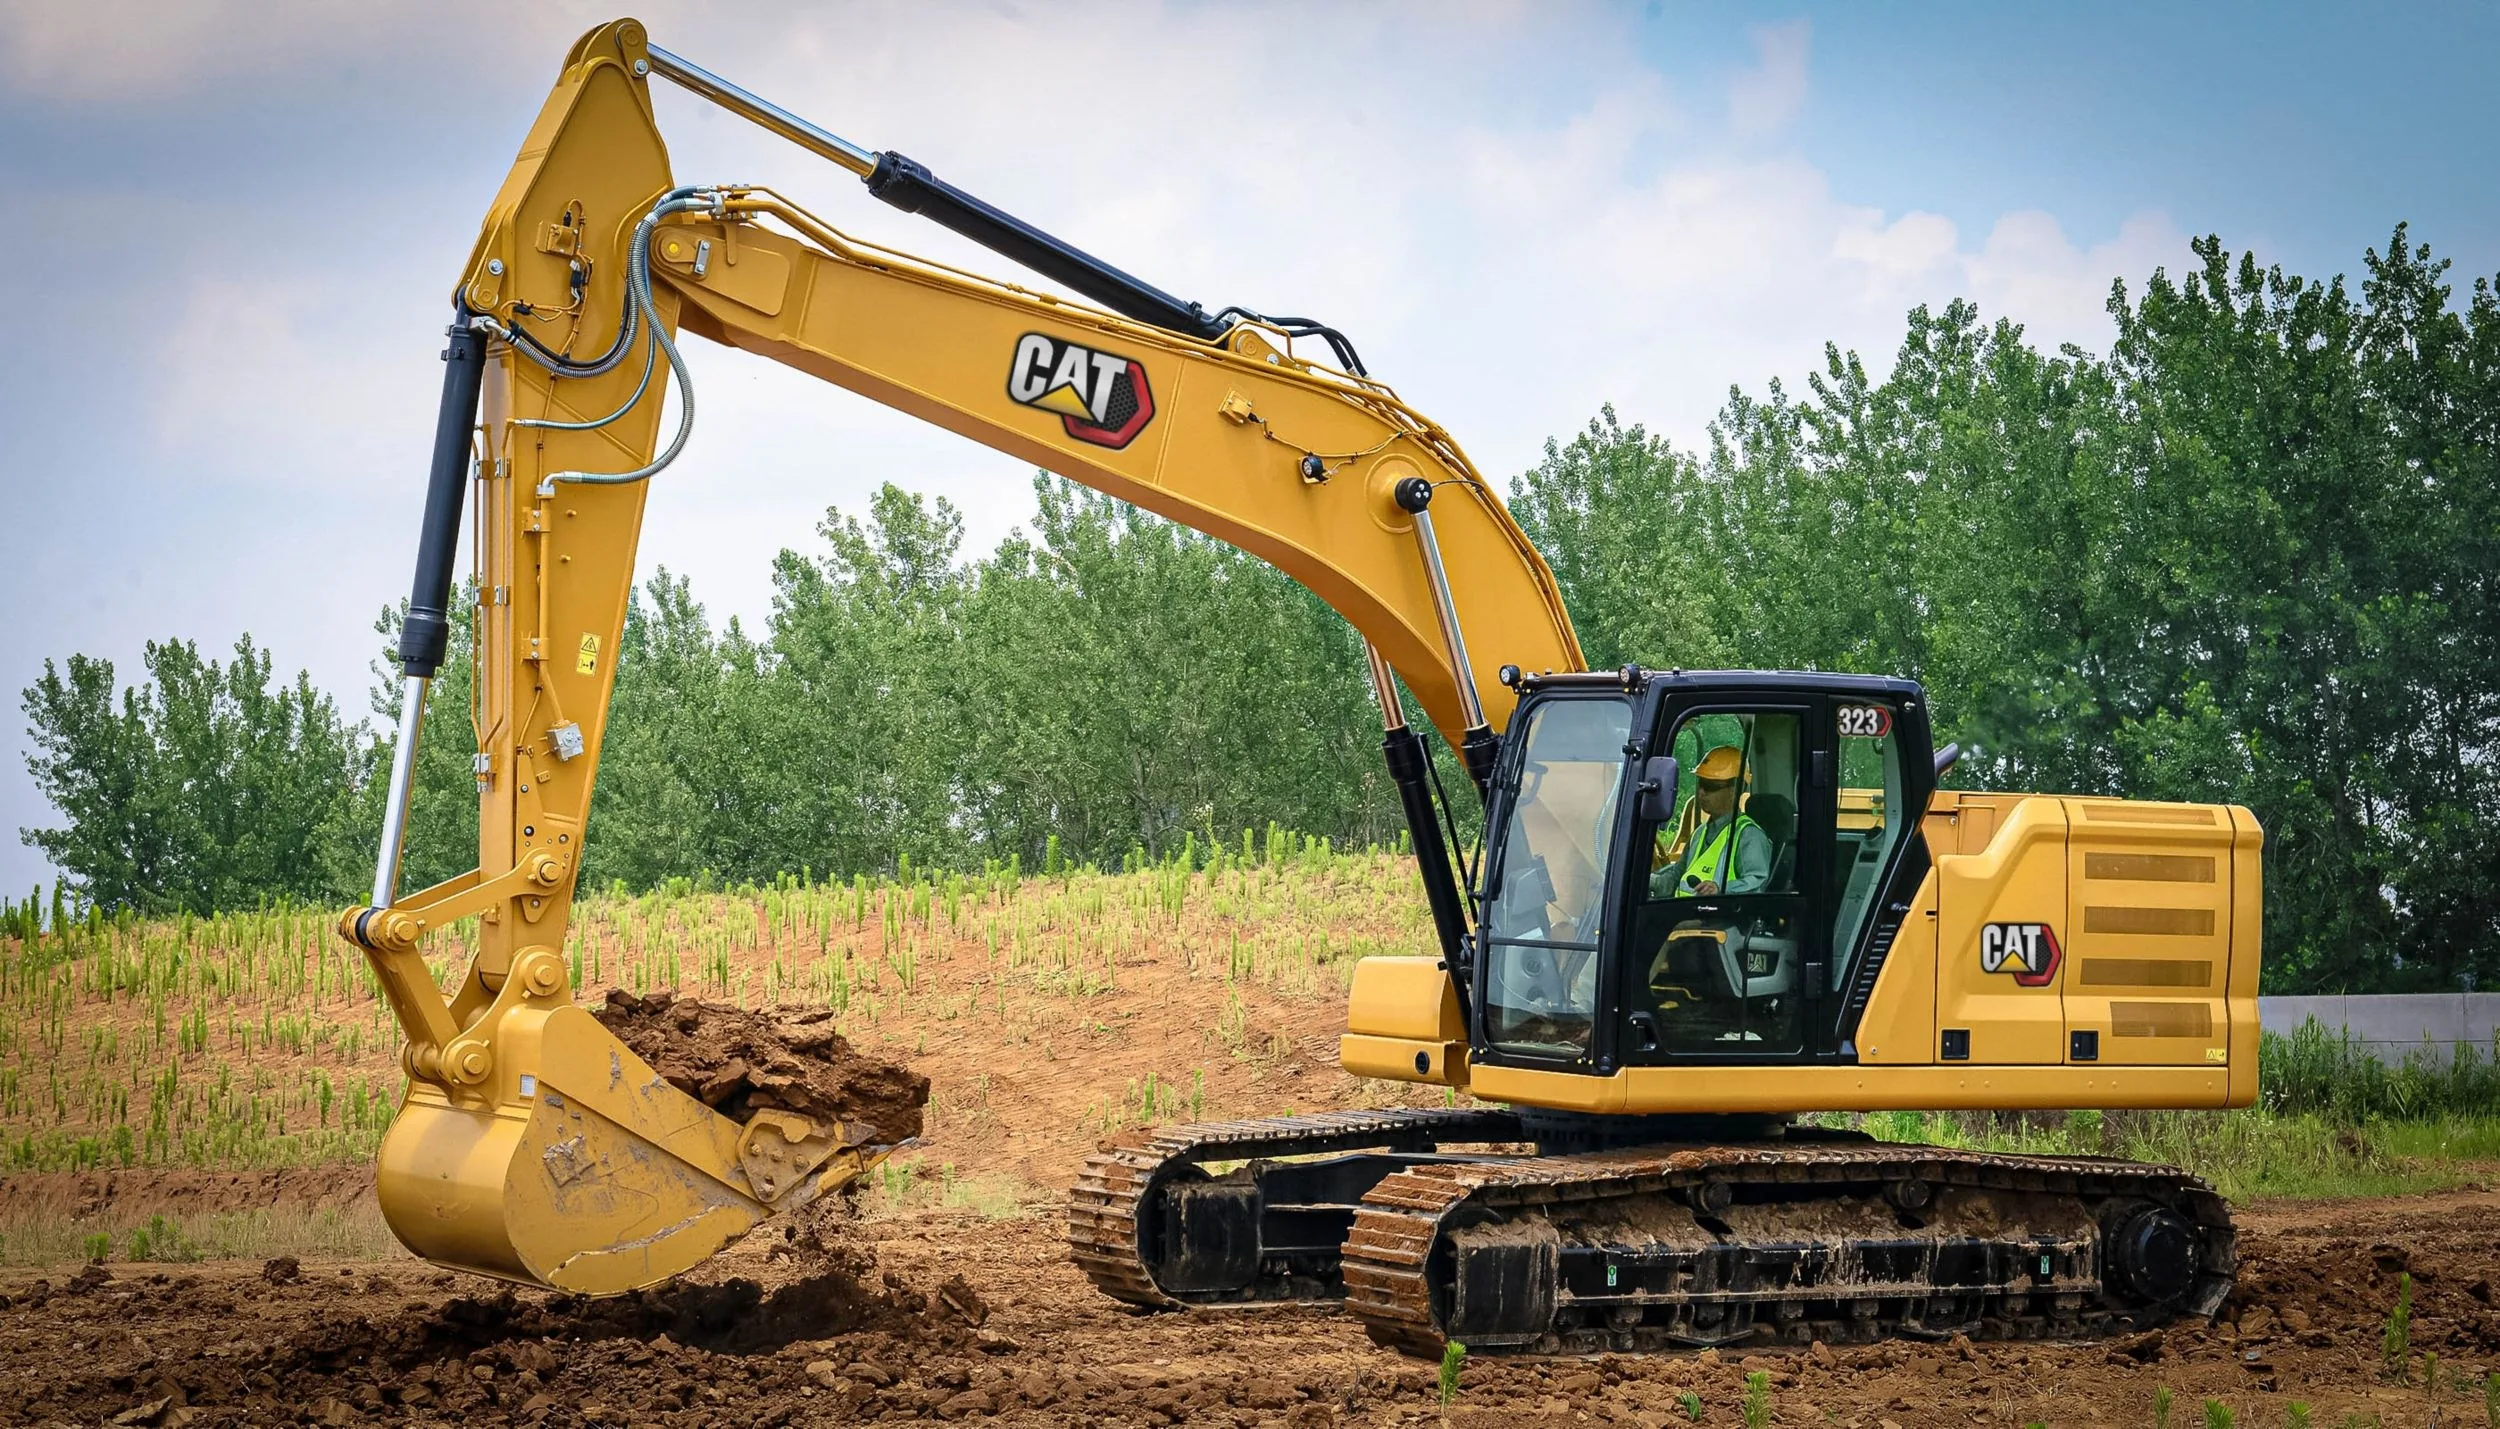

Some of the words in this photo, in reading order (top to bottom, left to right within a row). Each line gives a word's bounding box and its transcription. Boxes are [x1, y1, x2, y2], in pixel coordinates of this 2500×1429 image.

[1010, 334, 1127, 423] CAT
[1839, 708, 1877, 735] 323
[1748, 952, 1767, 972] CAT
[1982, 924, 2041, 972] CAT
